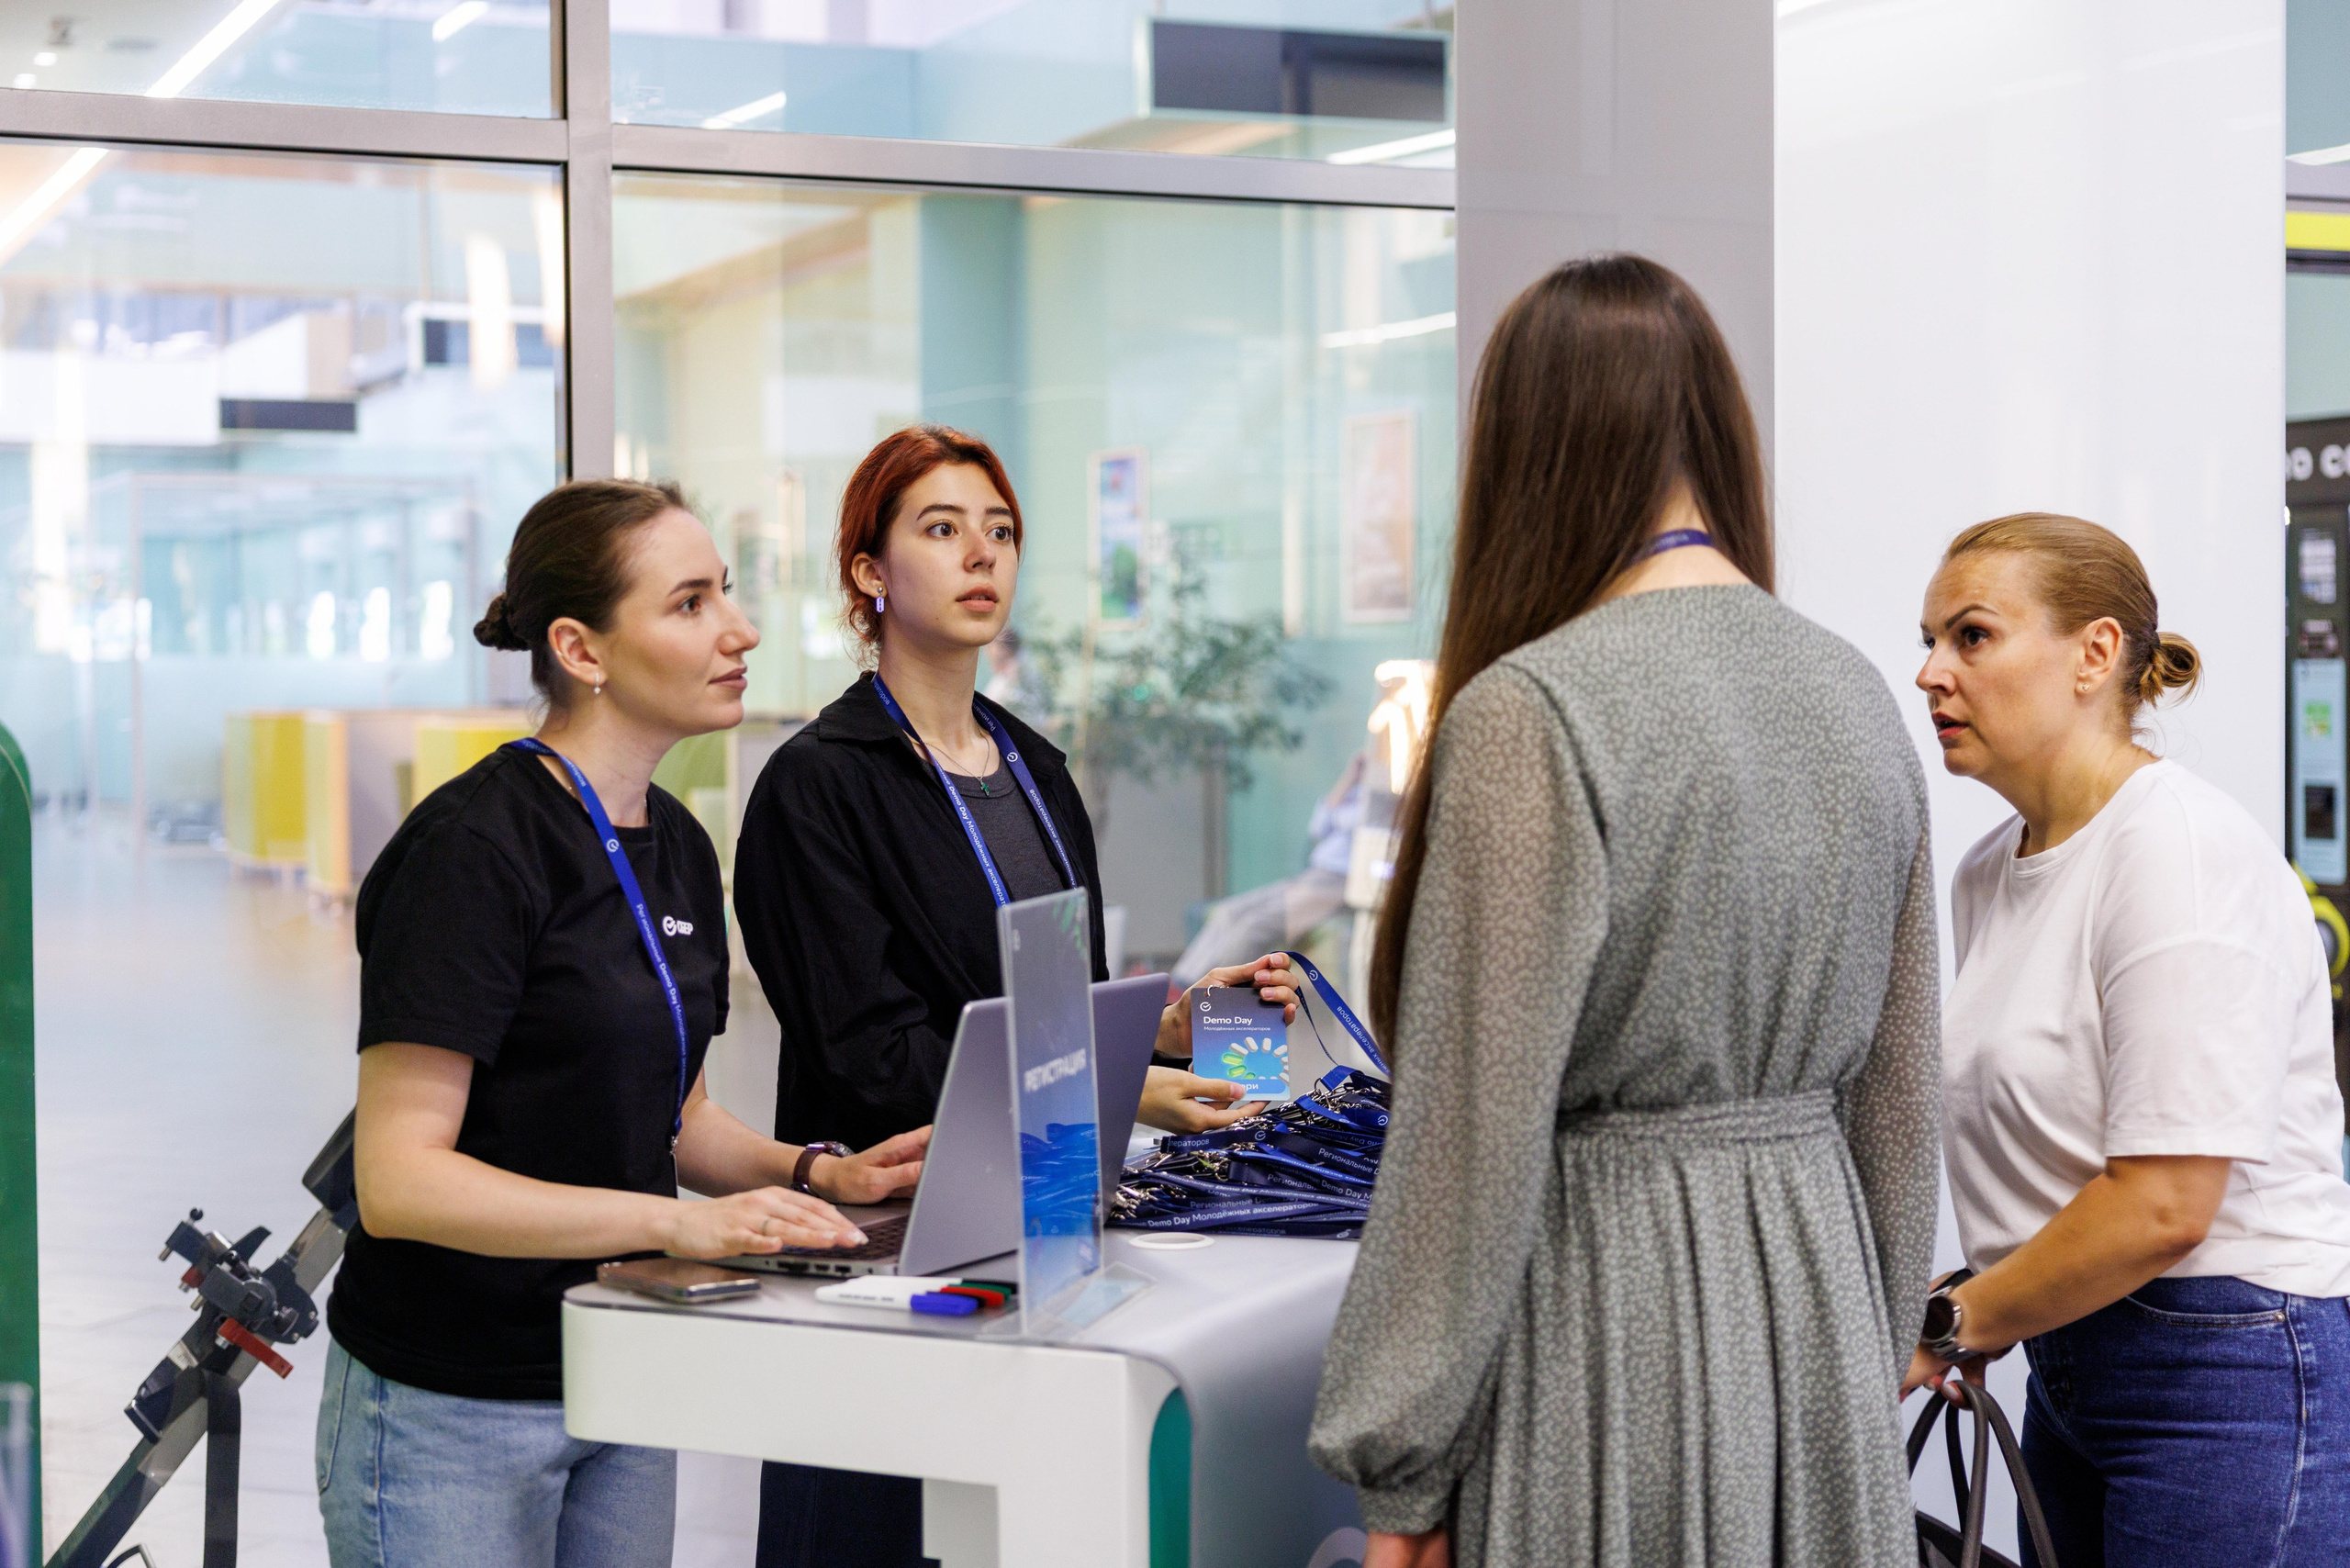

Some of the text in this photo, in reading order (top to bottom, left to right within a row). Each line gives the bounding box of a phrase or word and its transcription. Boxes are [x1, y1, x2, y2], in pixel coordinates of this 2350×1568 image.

[973, 702, 996, 733] Регионал
[948, 786, 1007, 907] Demo Day Молодёжных акселерат
[658, 962, 673, 988] Demo
[1203, 1016, 1253, 1025] Demo Day
[1337, 1006, 1375, 1054] акселераторов
[1318, 1148, 1373, 1173] Региональные
[1267, 1173, 1315, 1191] Региональ
[1321, 1180, 1344, 1194] Demo
[1345, 1188, 1362, 1199] Day
[1190, 1197, 1253, 1209] Региональные
[1316, 1195, 1371, 1208] акселератор
[1173, 1215, 1191, 1225] Day
[1192, 1208, 1251, 1222] Молодёжных
